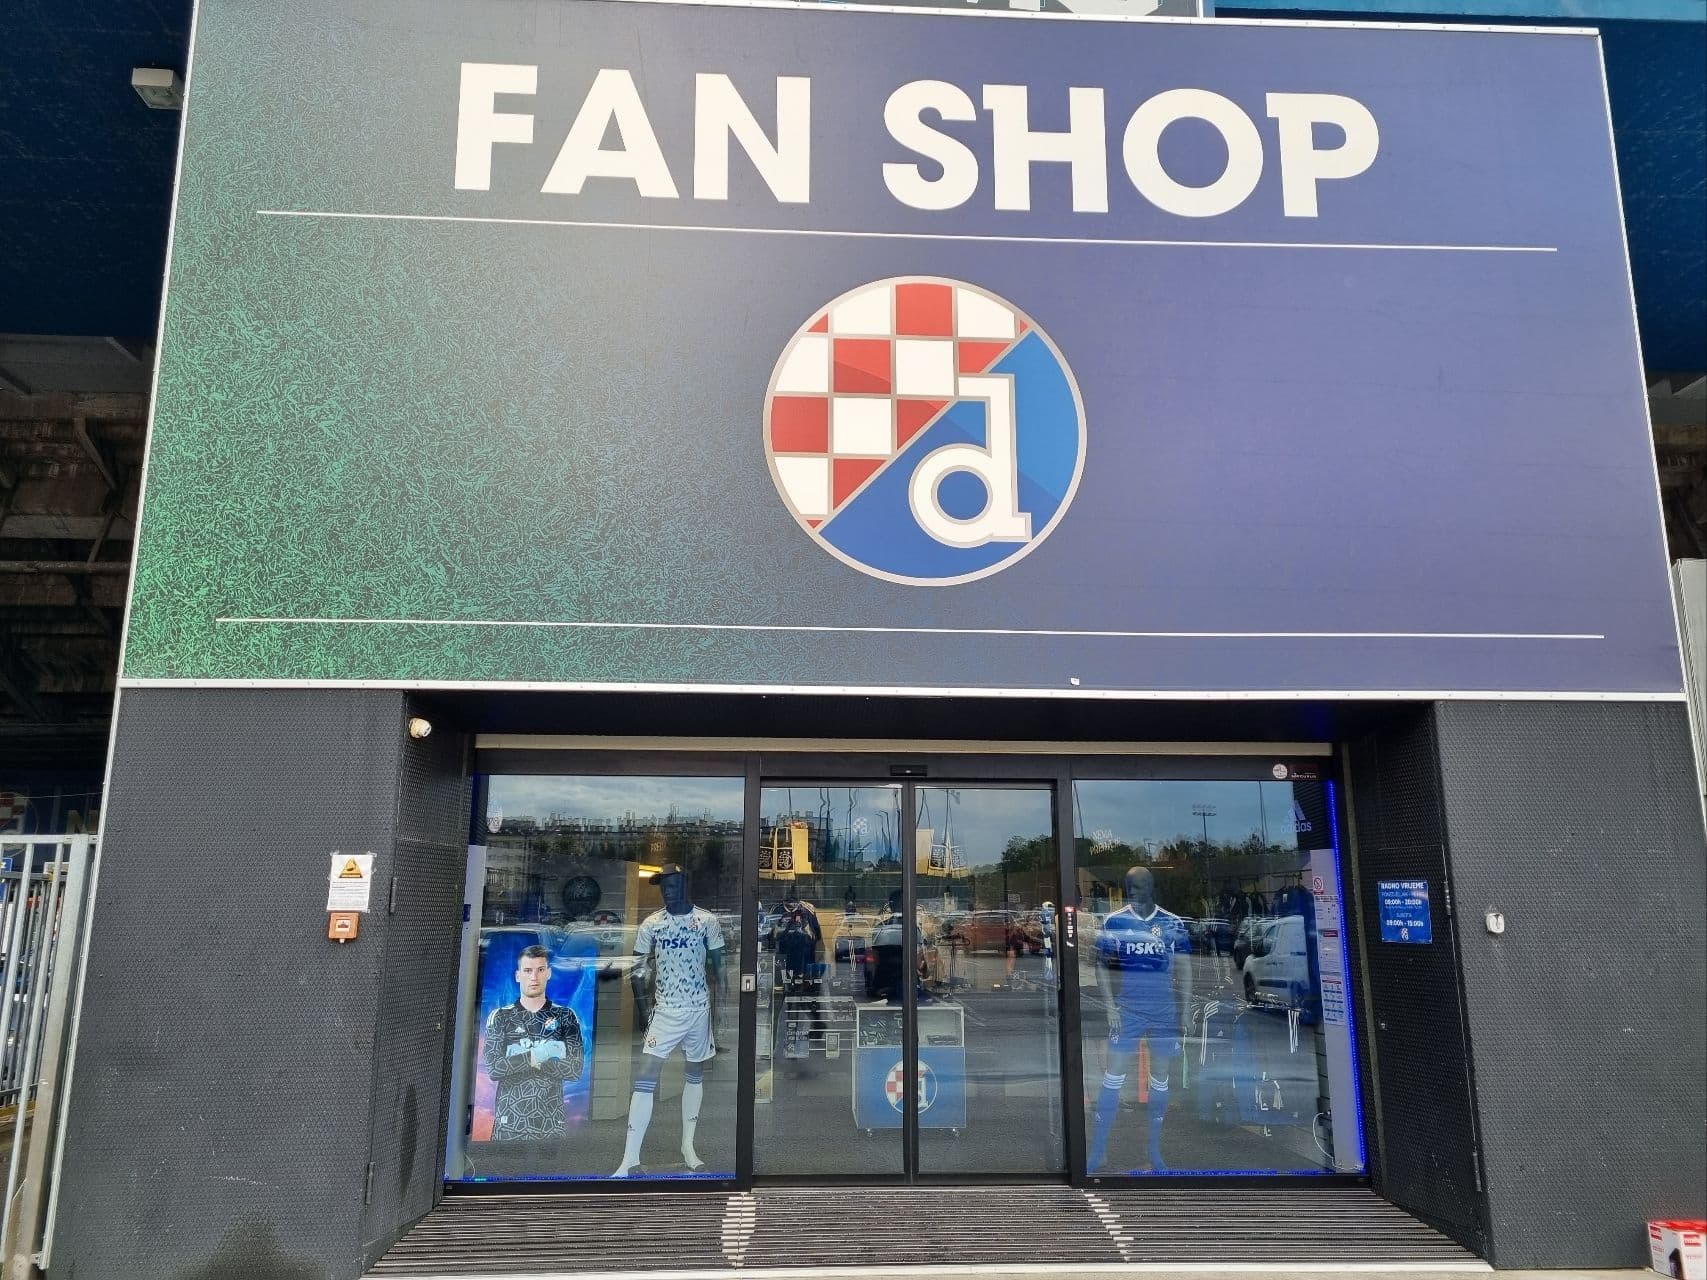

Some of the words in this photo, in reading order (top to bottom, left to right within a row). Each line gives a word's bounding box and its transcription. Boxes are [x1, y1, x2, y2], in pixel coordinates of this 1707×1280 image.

[455, 62, 811, 204] FAN
[882, 79, 1380, 219] SHOP
[1280, 819, 1312, 833] adidas
[1400, 881, 1424, 889] VRIJEME
[661, 936, 690, 950] PSK
[1126, 941, 1154, 955] PSK
